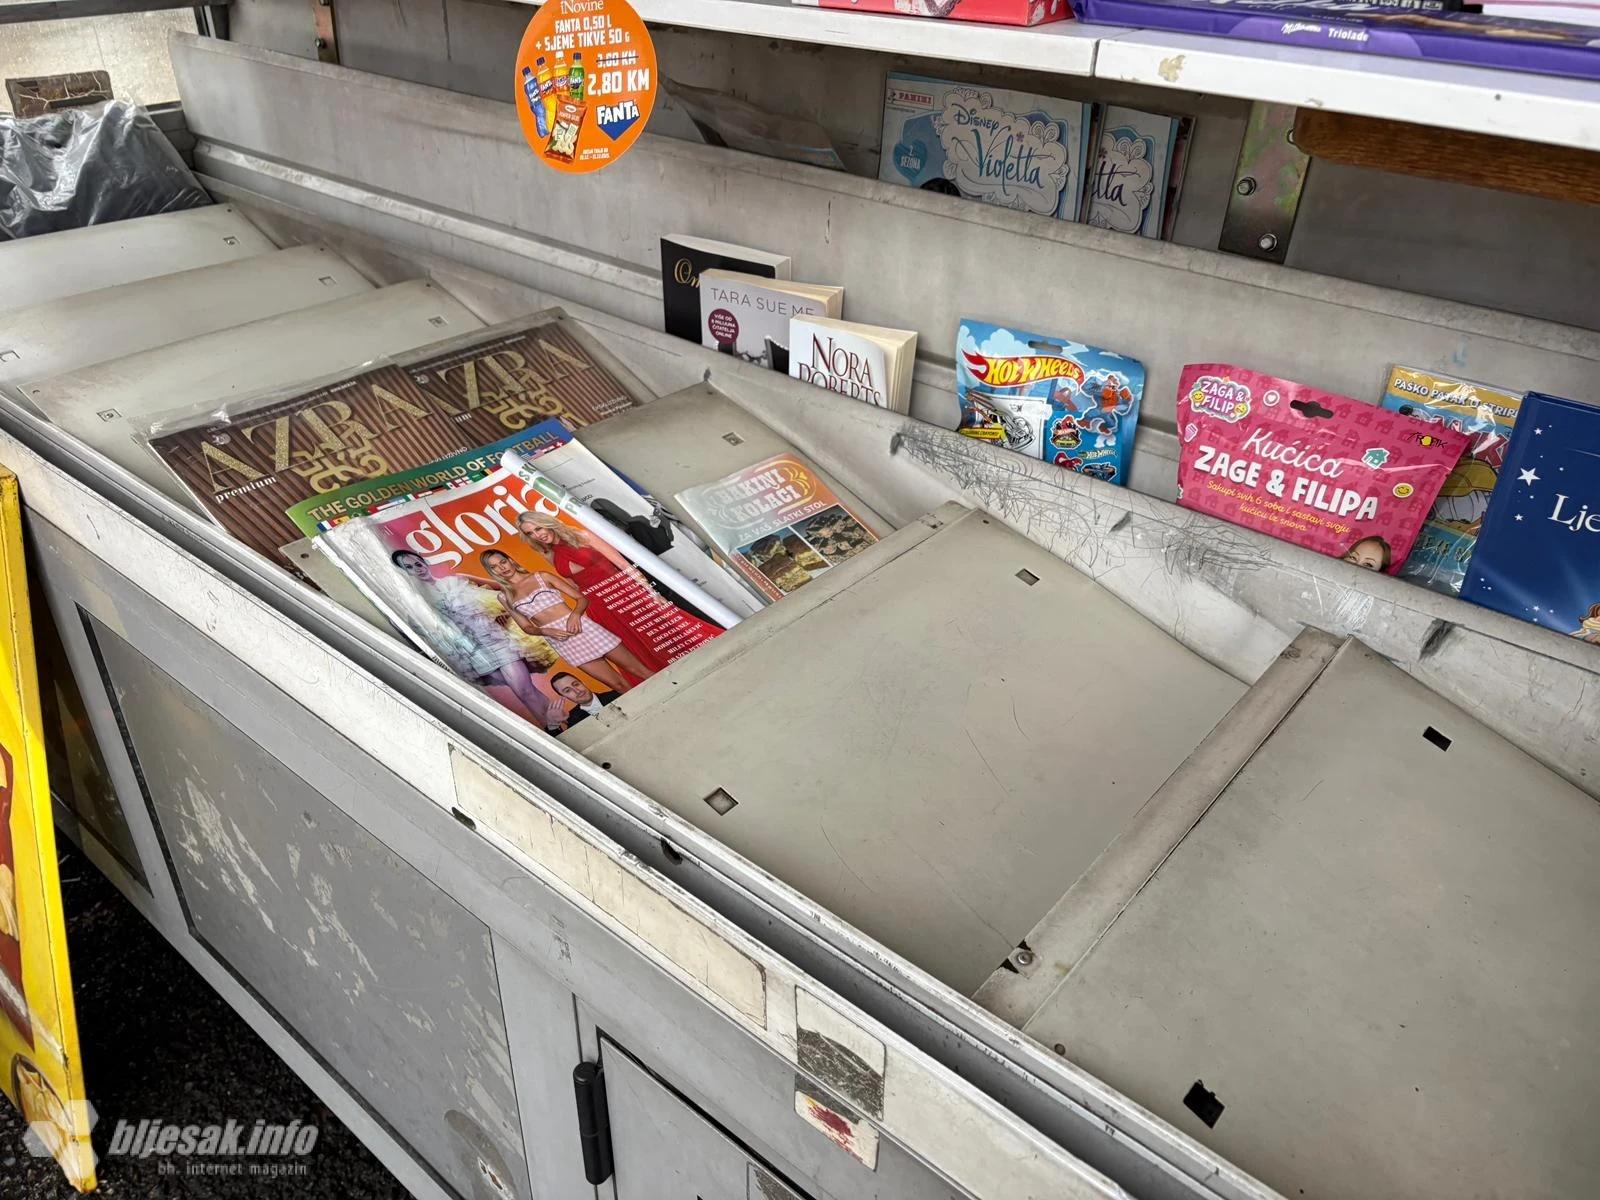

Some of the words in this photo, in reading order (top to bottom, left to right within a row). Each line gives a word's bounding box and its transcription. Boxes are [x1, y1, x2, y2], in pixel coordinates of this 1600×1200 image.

[561, 0, 604, 14] iNovine
[555, 18, 581, 33] FANTA
[583, 15, 604, 31] 0,50
[607, 15, 612, 28] L
[1328, 27, 1369, 42] Triolade
[535, 41, 541, 49] +
[544, 34, 575, 51] SJEME
[577, 31, 606, 47] TIKVE
[609, 28, 622, 44] 50
[625, 32, 630, 42] G
[621, 50, 637, 65] KM
[587, 72, 622, 97] 2,80
[627, 68, 650, 92] KM
[898, 92, 932, 104] PANINI
[596, 101, 639, 125] FANTA
[900, 155, 920, 169] SEZONA
[958, 127, 1050, 195] Violetta
[710, 287, 751, 307] TARA
[756, 297, 787, 315] SUE
[792, 305, 815, 317] ME
[811, 332, 873, 388] NORA
[985, 357, 1016, 385] HOT
[1201, 381, 1234, 400] ZAGA
[1235, 391, 1244, 402] &
[1430, 389, 1467, 405] PATAK
[1201, 395, 1235, 413] FILIP
[201, 383, 431, 494] AZRA
[307, 500, 346, 520] THE
[345, 482, 413, 509] GOLDEN
[410, 466, 467, 489] WORLD
[466, 457, 486, 471] OF
[486, 431, 559, 464] FOTBALL
[716, 468, 786, 504] BAKINI
[1193, 445, 1262, 488] ZAGE
[1265, 469, 1286, 498] &
[1291, 477, 1378, 521] FILIPA
[214, 475, 278, 504] premium
[730, 484, 801, 521] KOLAČI
[772, 511, 804, 527] SLATKI
[804, 500, 828, 514] STOL
[1207, 481, 1235, 497] Sakupi
[1237, 492, 1254, 503] svih
[1255, 496, 1262, 505] 6
[1264, 500, 1285, 513] soba
[1291, 510, 1324, 526] sastavi
[1326, 521, 1351, 534] svoju
[405, 483, 560, 570] gloria
[1280, 518, 1307, 532] snova
[582, 576, 616, 596] KATHARINE
[595, 582, 621, 597] MARGOT
[607, 596, 630, 610] MONICA
[629, 610, 659, 626] HARRISON
[657, 601, 674, 612] FORD
[632, 606, 646, 616] RITA
[637, 621, 655, 632] KYLIE
[653, 607, 679, 623] MINOGUE
[646, 628, 659, 637] BEN
[658, 616, 683, 630] AFFLECK
[652, 632, 669, 643] COCO
[667, 620, 690, 635] CHANEL
[684, 633, 703, 645] CYRUS
